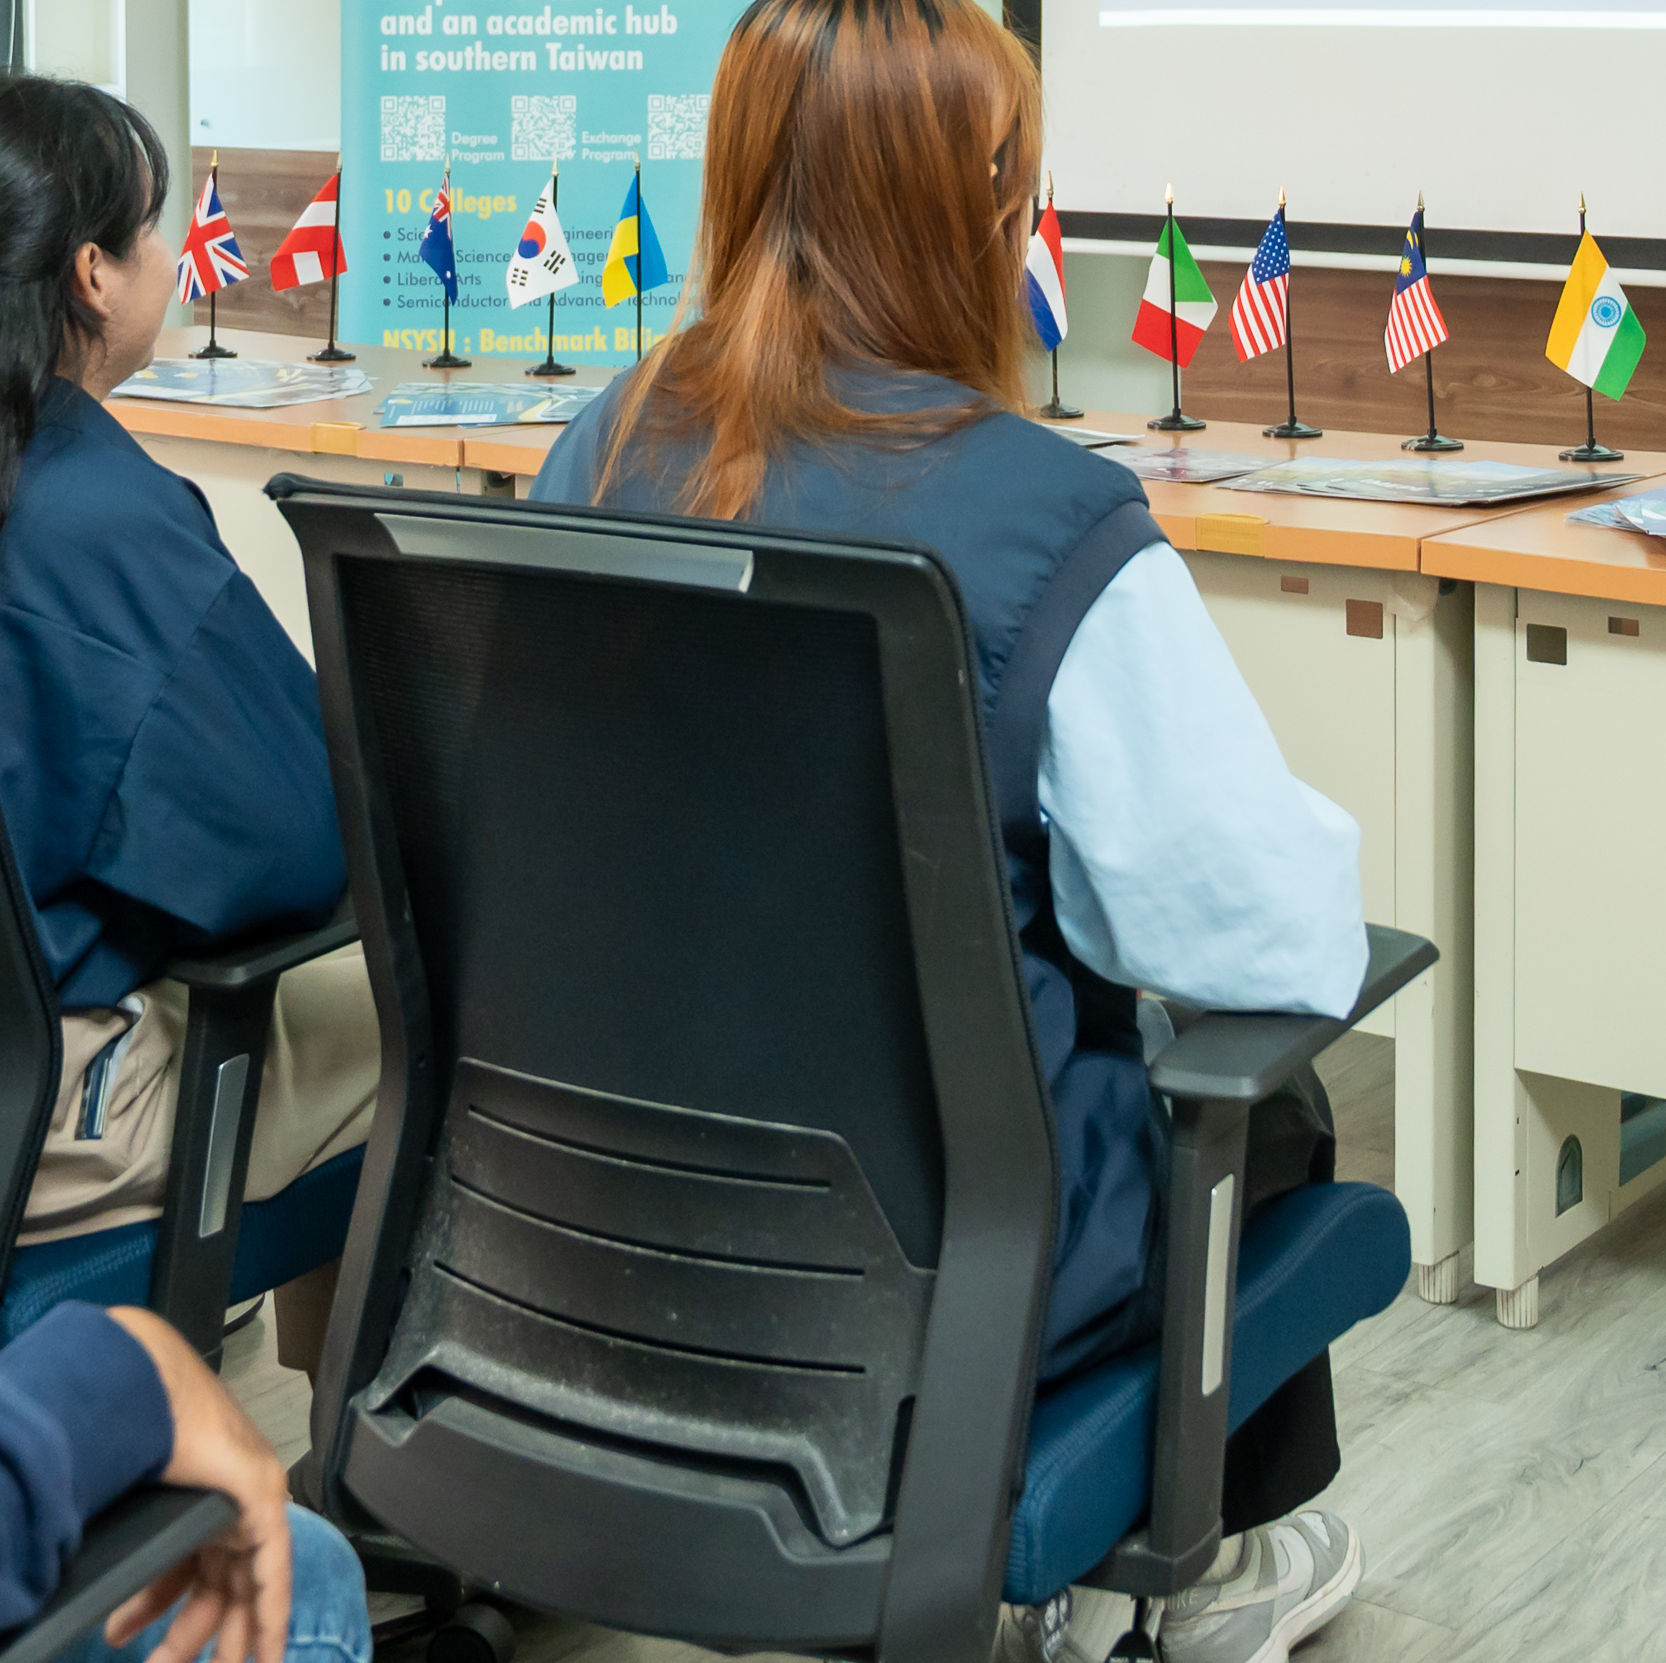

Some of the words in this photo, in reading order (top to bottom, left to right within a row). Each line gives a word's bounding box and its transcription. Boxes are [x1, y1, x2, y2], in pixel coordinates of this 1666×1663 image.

[380, 5, 433, 36] and
[442, 12, 477, 35] an
[486, 5, 618, 36] academic
[625, 4, 678, 35] hub
[380, 44, 406, 71] in
[415, 41, 537, 71] southern
[546, 42, 644, 71] Taiwan
[451, 132, 498, 146] Degree
[581, 131, 642, 148] Exchange
[451, 149, 505, 165] Program
[581, 148, 637, 165] Program
[385, 189, 411, 213] 10
[419, 188, 517, 219] Clleges
[456, 250, 513, 263] Science
[397, 272, 443, 286] Libera
[456, 272, 482, 286] Arts
[384, 328, 455, 352] NSYSU
[480, 326, 608, 352] Benchmark
